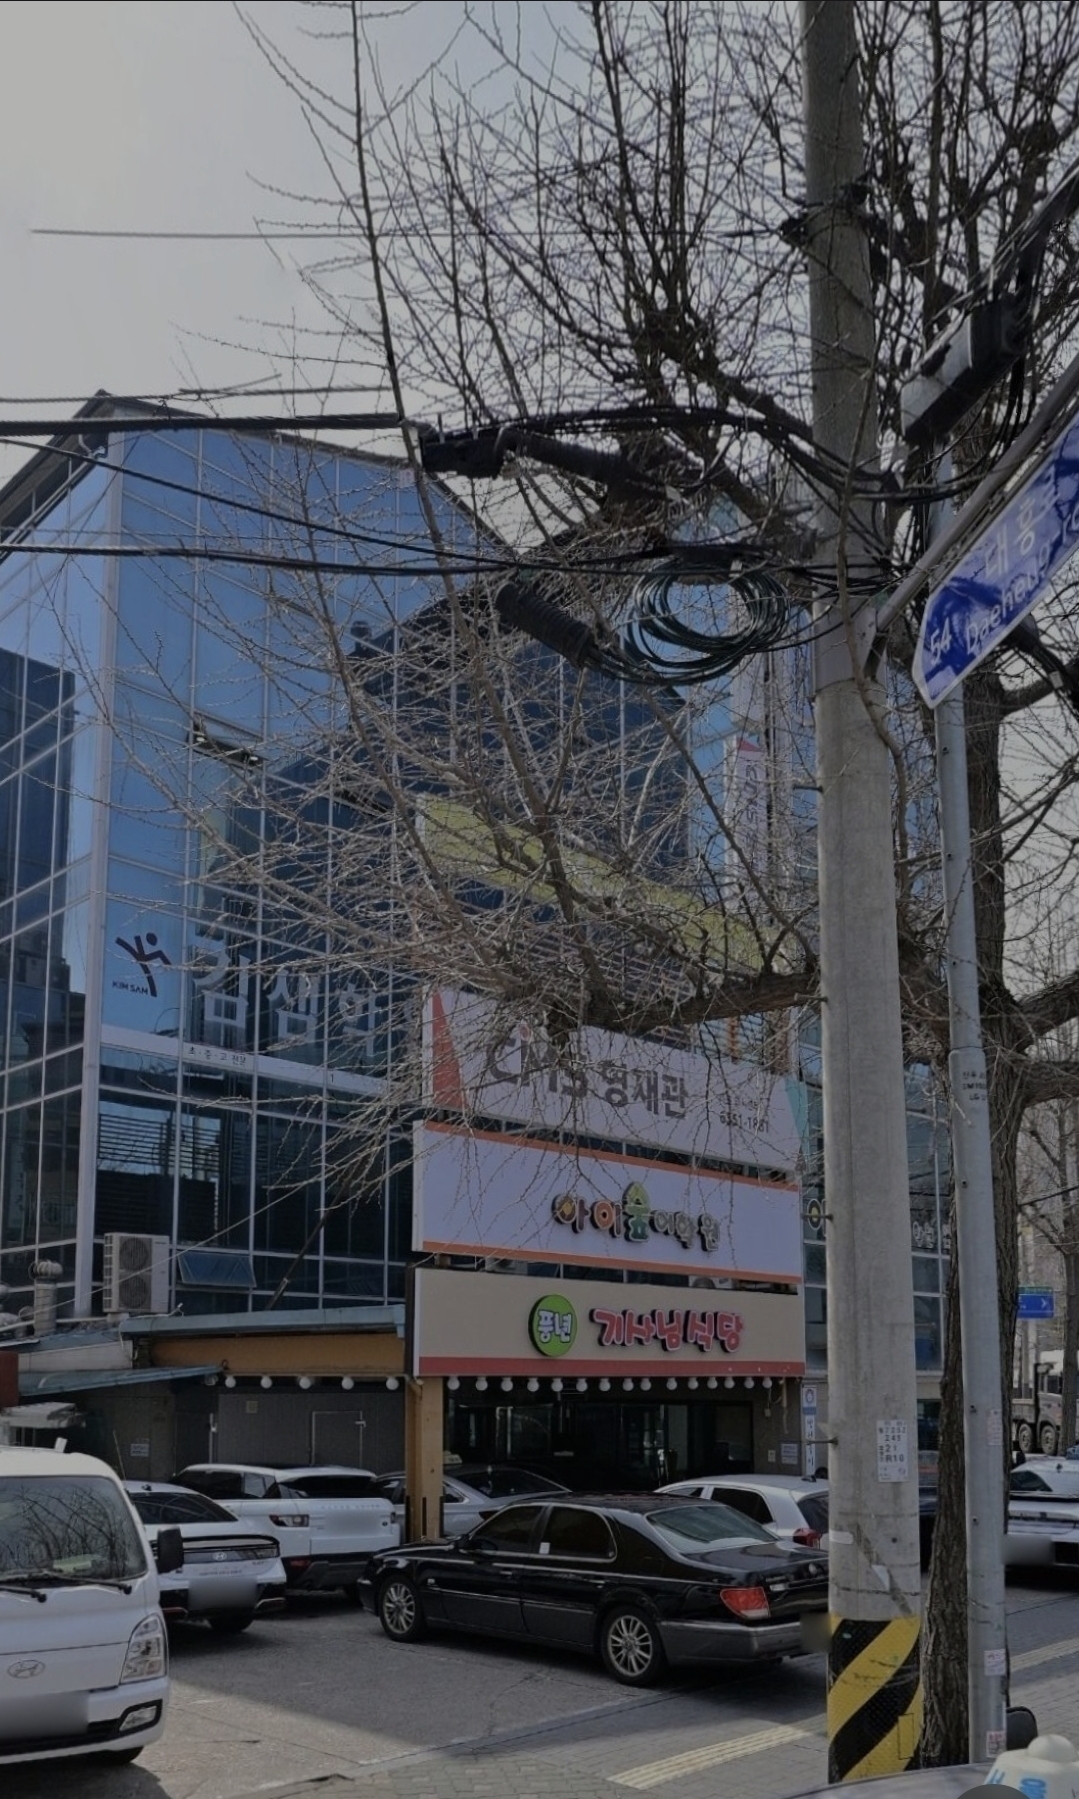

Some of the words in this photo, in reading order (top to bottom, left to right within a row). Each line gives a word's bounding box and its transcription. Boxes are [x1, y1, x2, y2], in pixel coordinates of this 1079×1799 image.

[985, 465, 1060, 576] 대흥로
[930, 616, 952, 667] 54
[112, 979, 128, 990] KIM
[131, 984, 148, 996] SAM
[599, 1059, 686, 1119] 영재관
[537, 1309, 573, 1343] 풍년
[589, 1307, 744, 1353] 기사님식당
